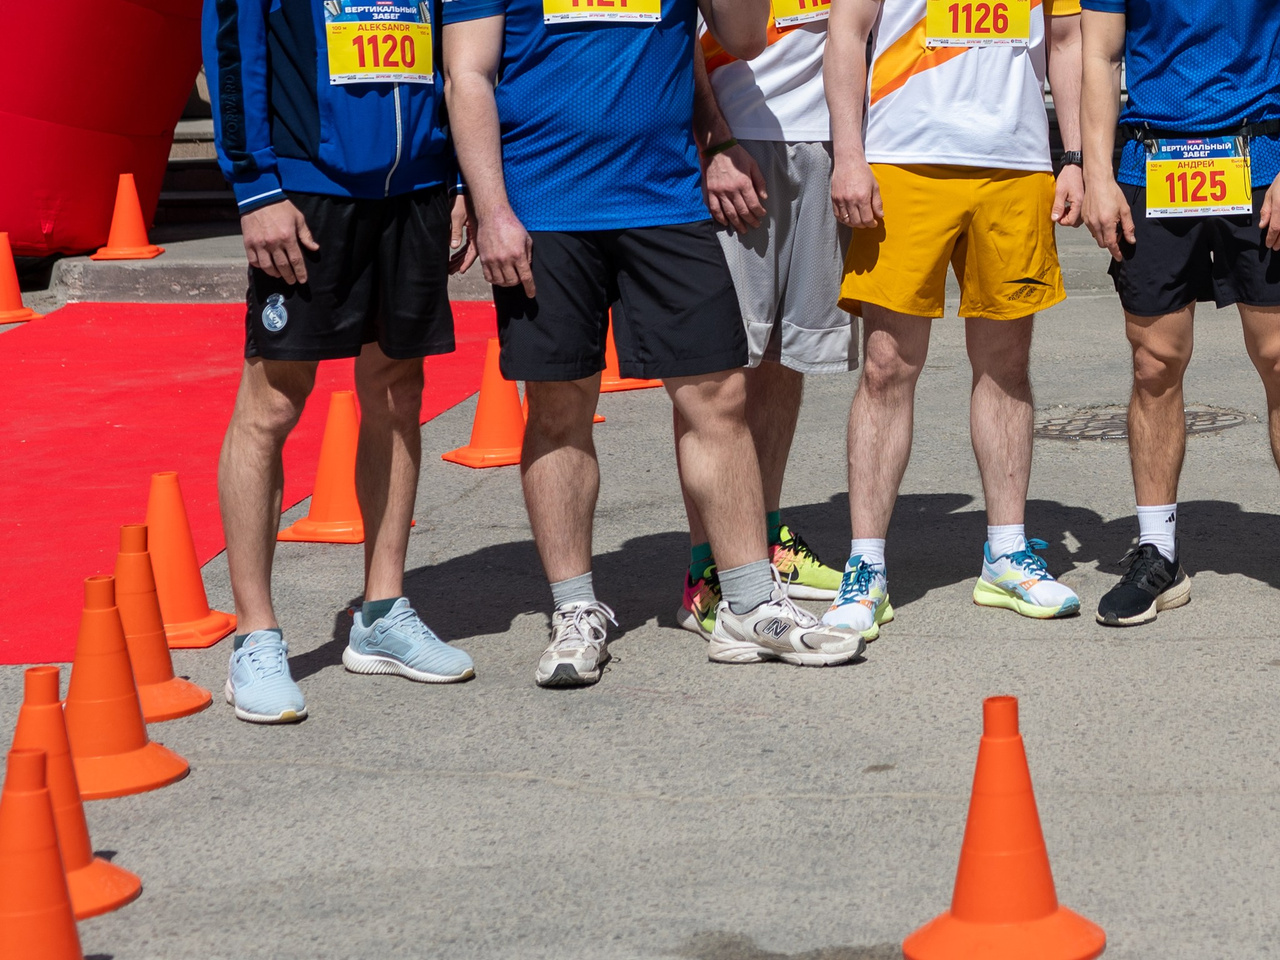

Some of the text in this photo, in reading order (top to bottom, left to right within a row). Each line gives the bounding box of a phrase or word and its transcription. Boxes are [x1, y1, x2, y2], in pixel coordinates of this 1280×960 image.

[344, 5, 417, 14] ВЕРТИКАЛЬНЫЙ
[948, 2, 1009, 34] 1126
[357, 23, 410, 32] ALEKSANDR
[352, 34, 416, 68] 1120
[1161, 142, 1232, 152] ВЕРТИКАЛЬНЫЙ
[1177, 159, 1215, 169] АНДРЕЙ
[1165, 170, 1227, 203] 1125
